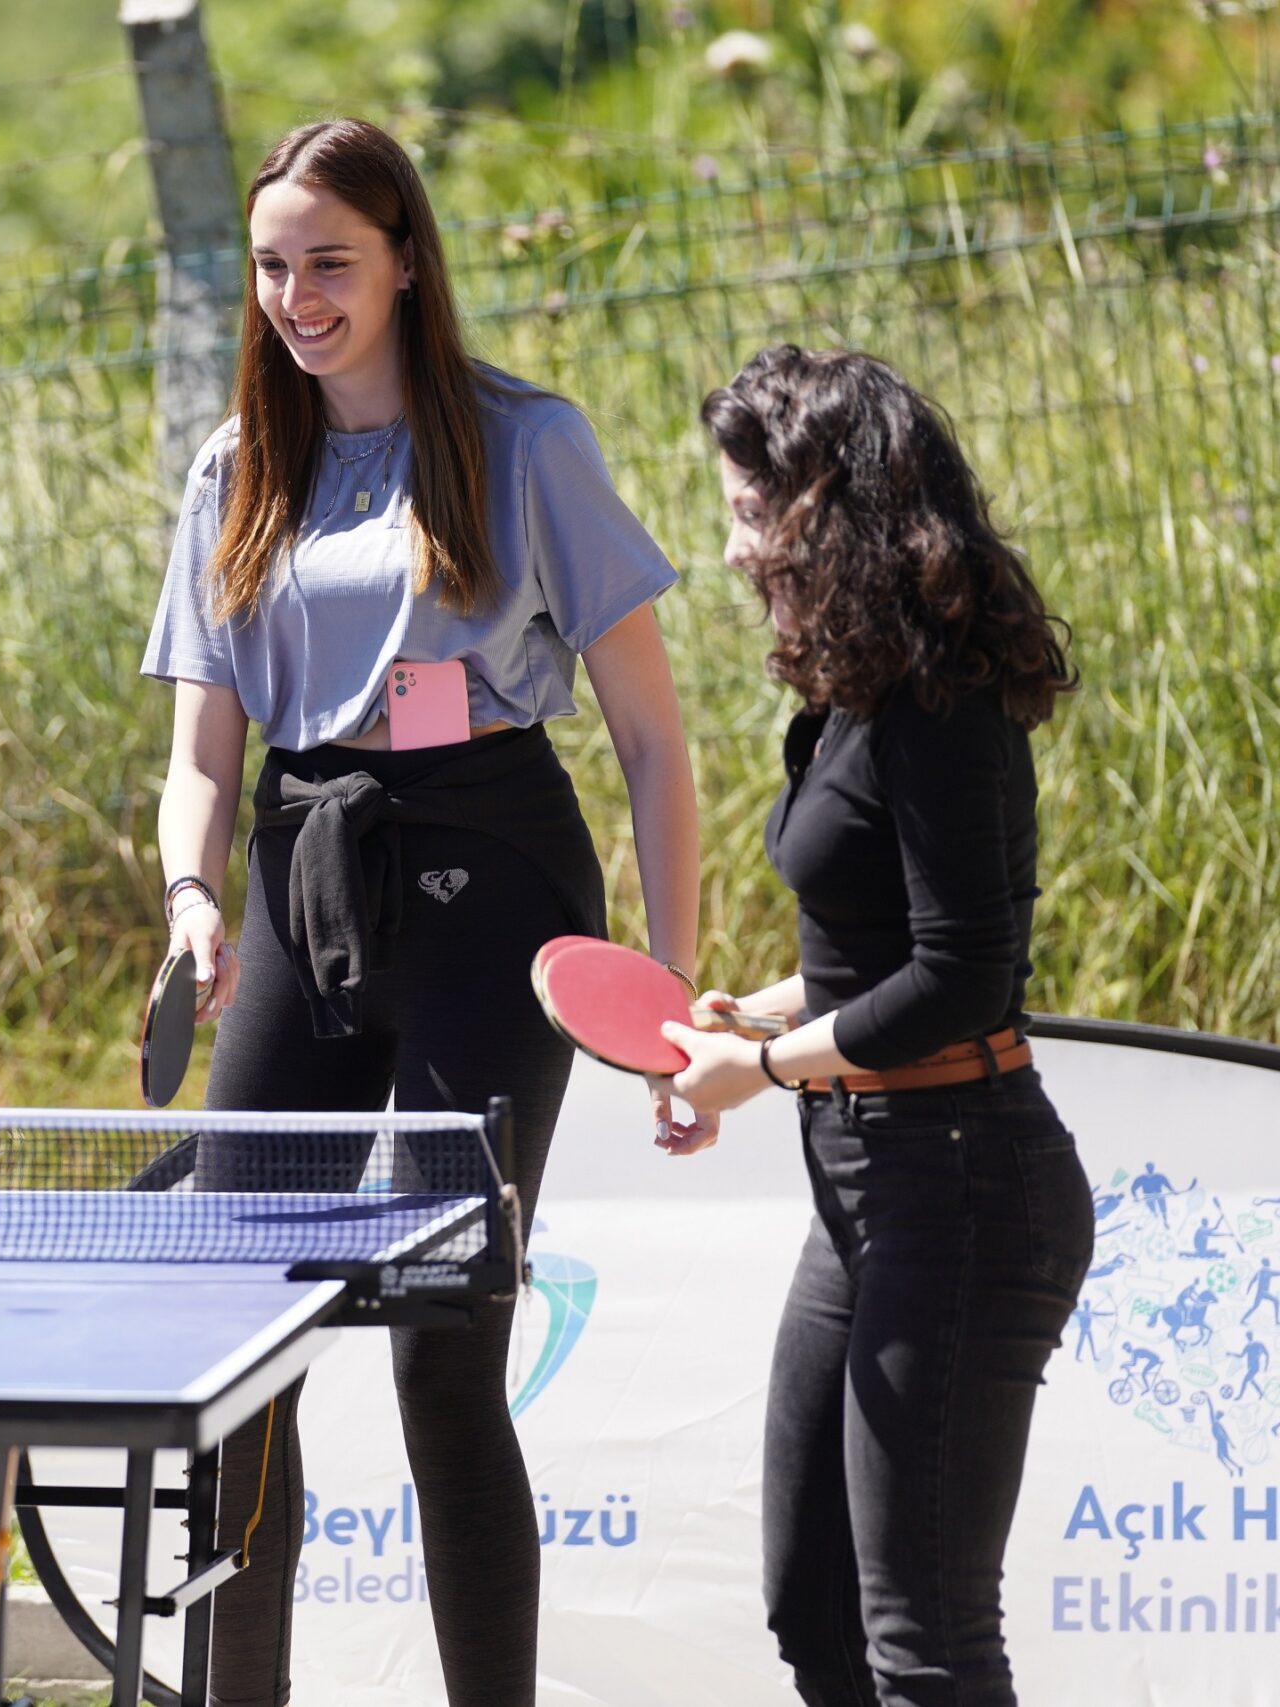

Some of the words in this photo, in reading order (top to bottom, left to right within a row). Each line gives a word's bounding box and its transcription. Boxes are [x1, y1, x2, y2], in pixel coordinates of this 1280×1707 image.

[1063, 1481, 1207, 1560] Açık
[1232, 1486, 1278, 1541] H
[293, 1556, 427, 1604] Beledi
